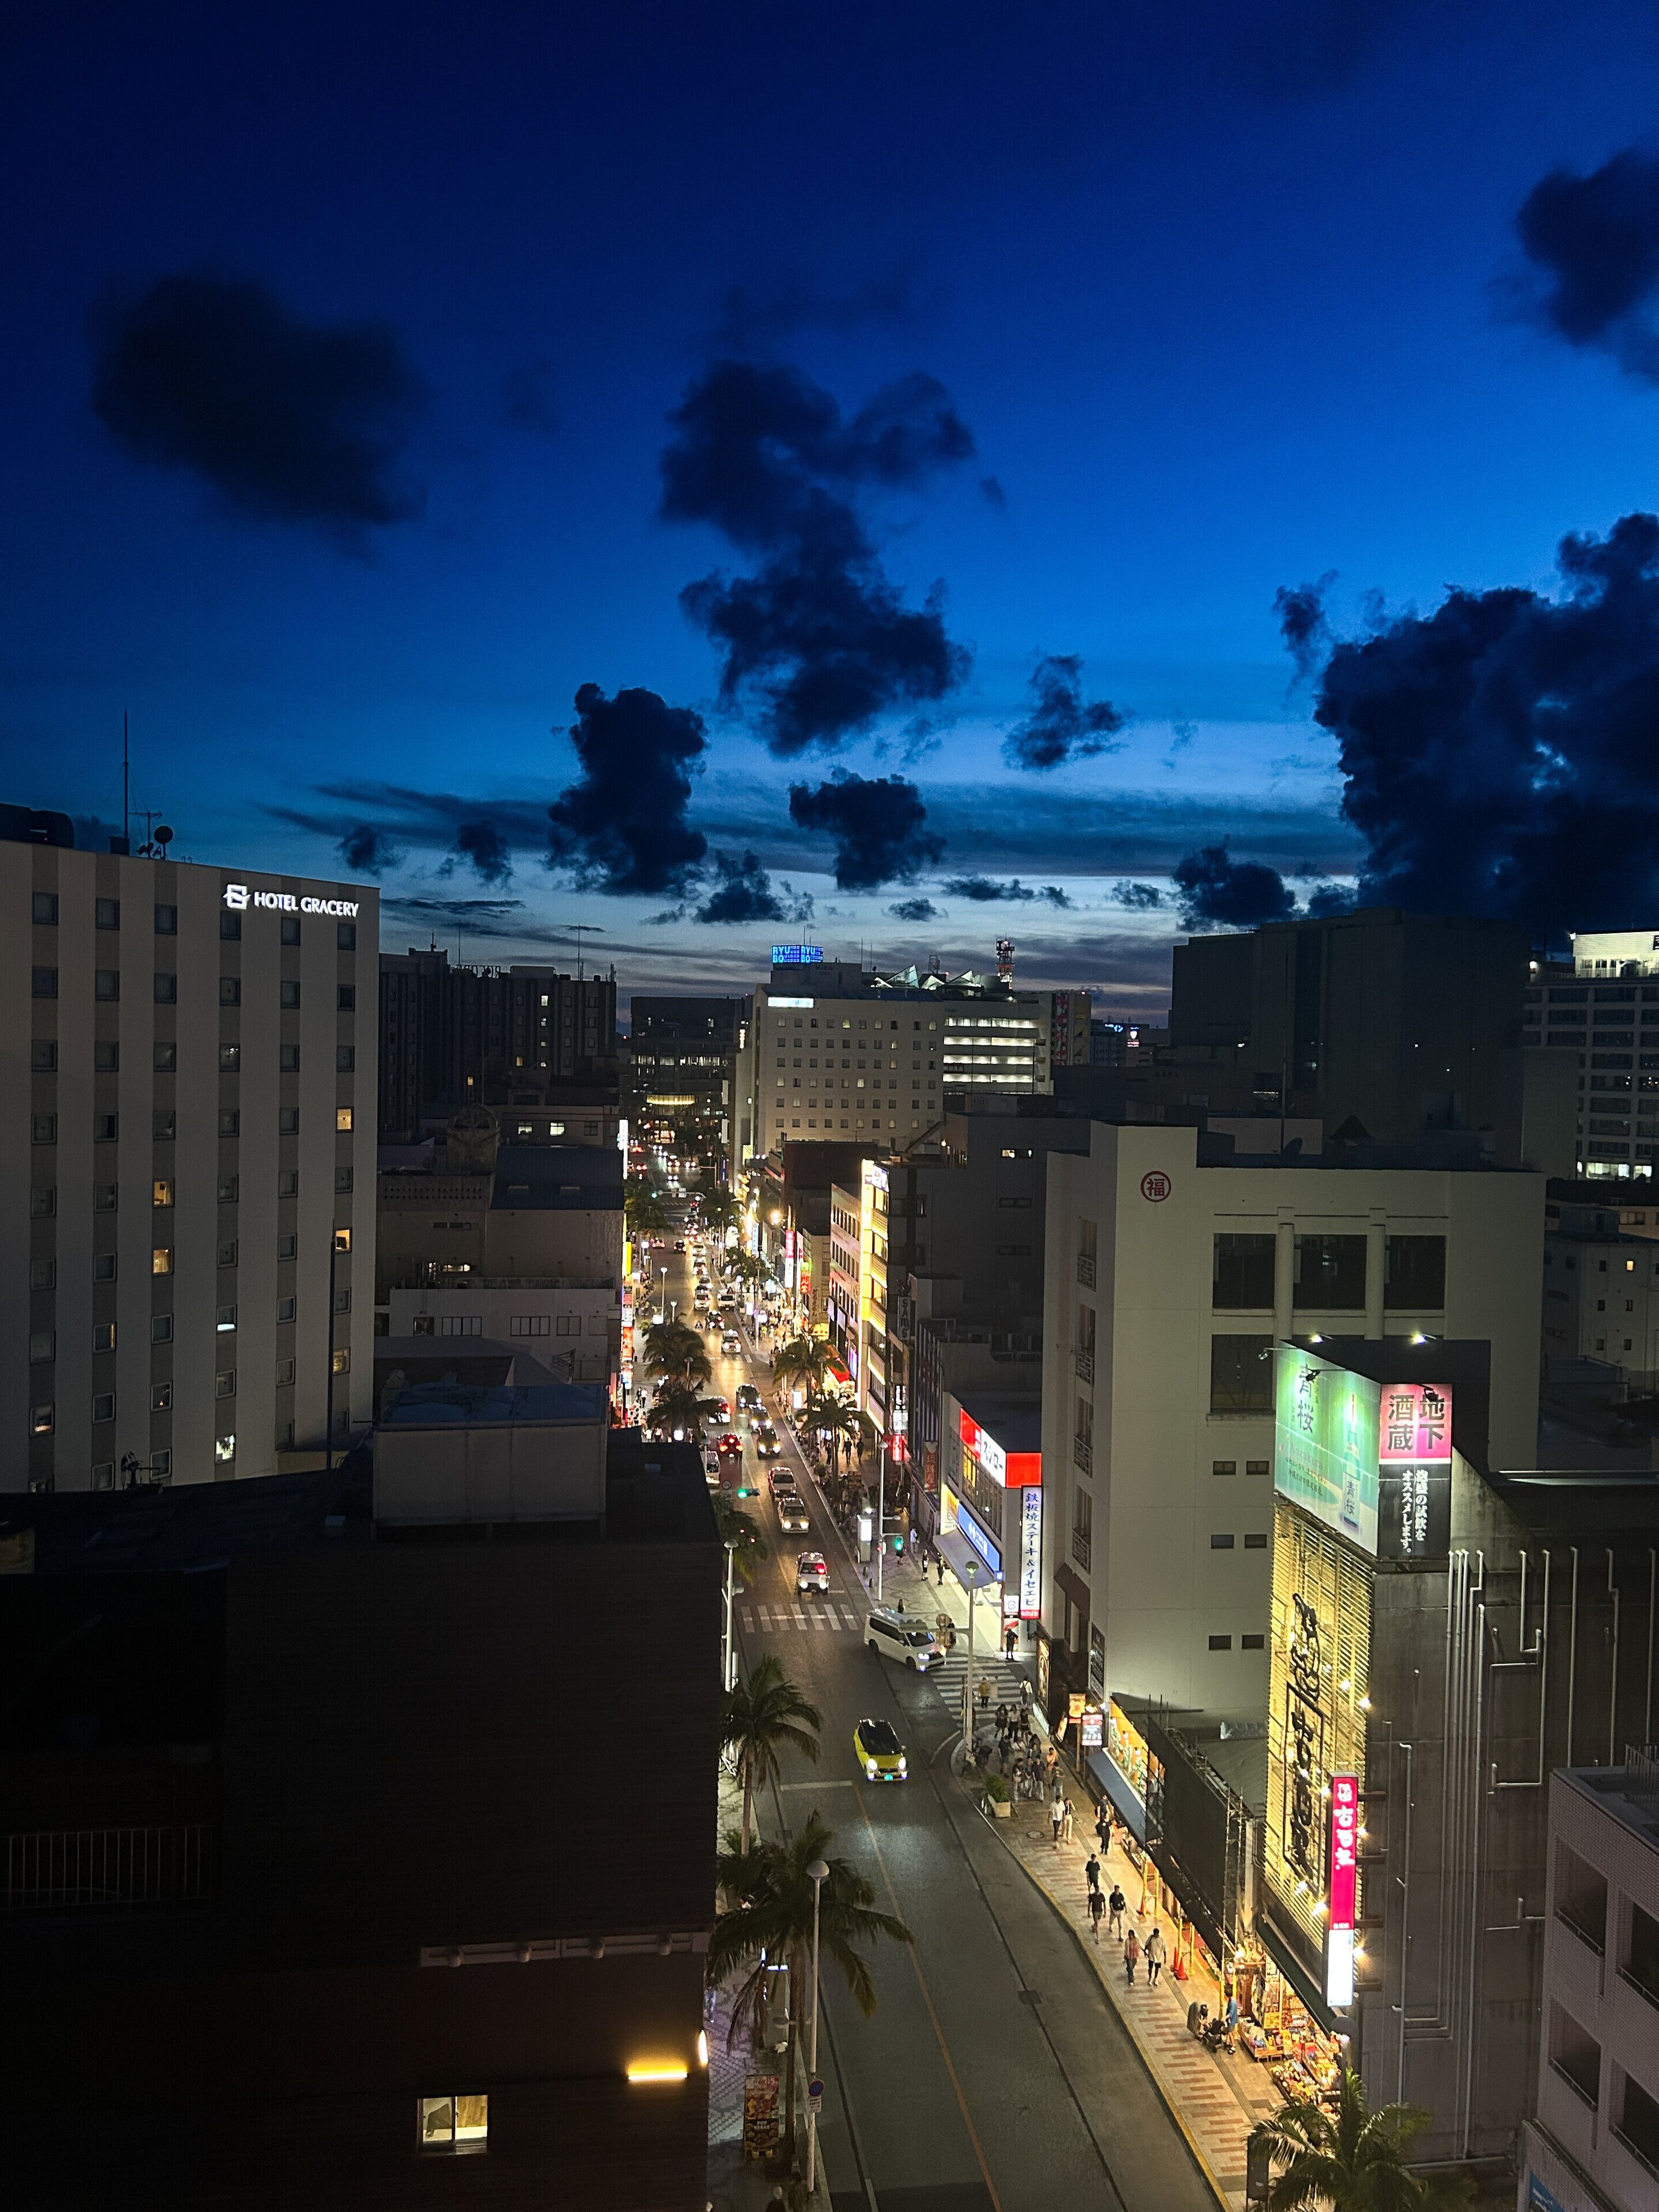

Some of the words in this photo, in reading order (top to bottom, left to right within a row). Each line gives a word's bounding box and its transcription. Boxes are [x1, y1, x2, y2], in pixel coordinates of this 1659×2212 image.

[254, 891, 298, 911] HOTEL
[301, 897, 359, 917] GRACERY
[772, 946, 790, 955] RYU
[772, 955, 784, 963] BO
[801, 946, 815, 955] RYU
[801, 955, 810, 963] BO
[1146, 1178, 1165, 1196] 福
[1297, 1363, 1314, 1433] 青桜
[1388, 1395, 1414, 1450] 酒蔵
[1420, 1393, 1445, 1449] 地下
[983, 1441, 1003, 1469] スシロー
[1400, 1469, 1413, 1553] オススメします。
[1415, 1469, 1429, 1541] 泡盛の試飲を
